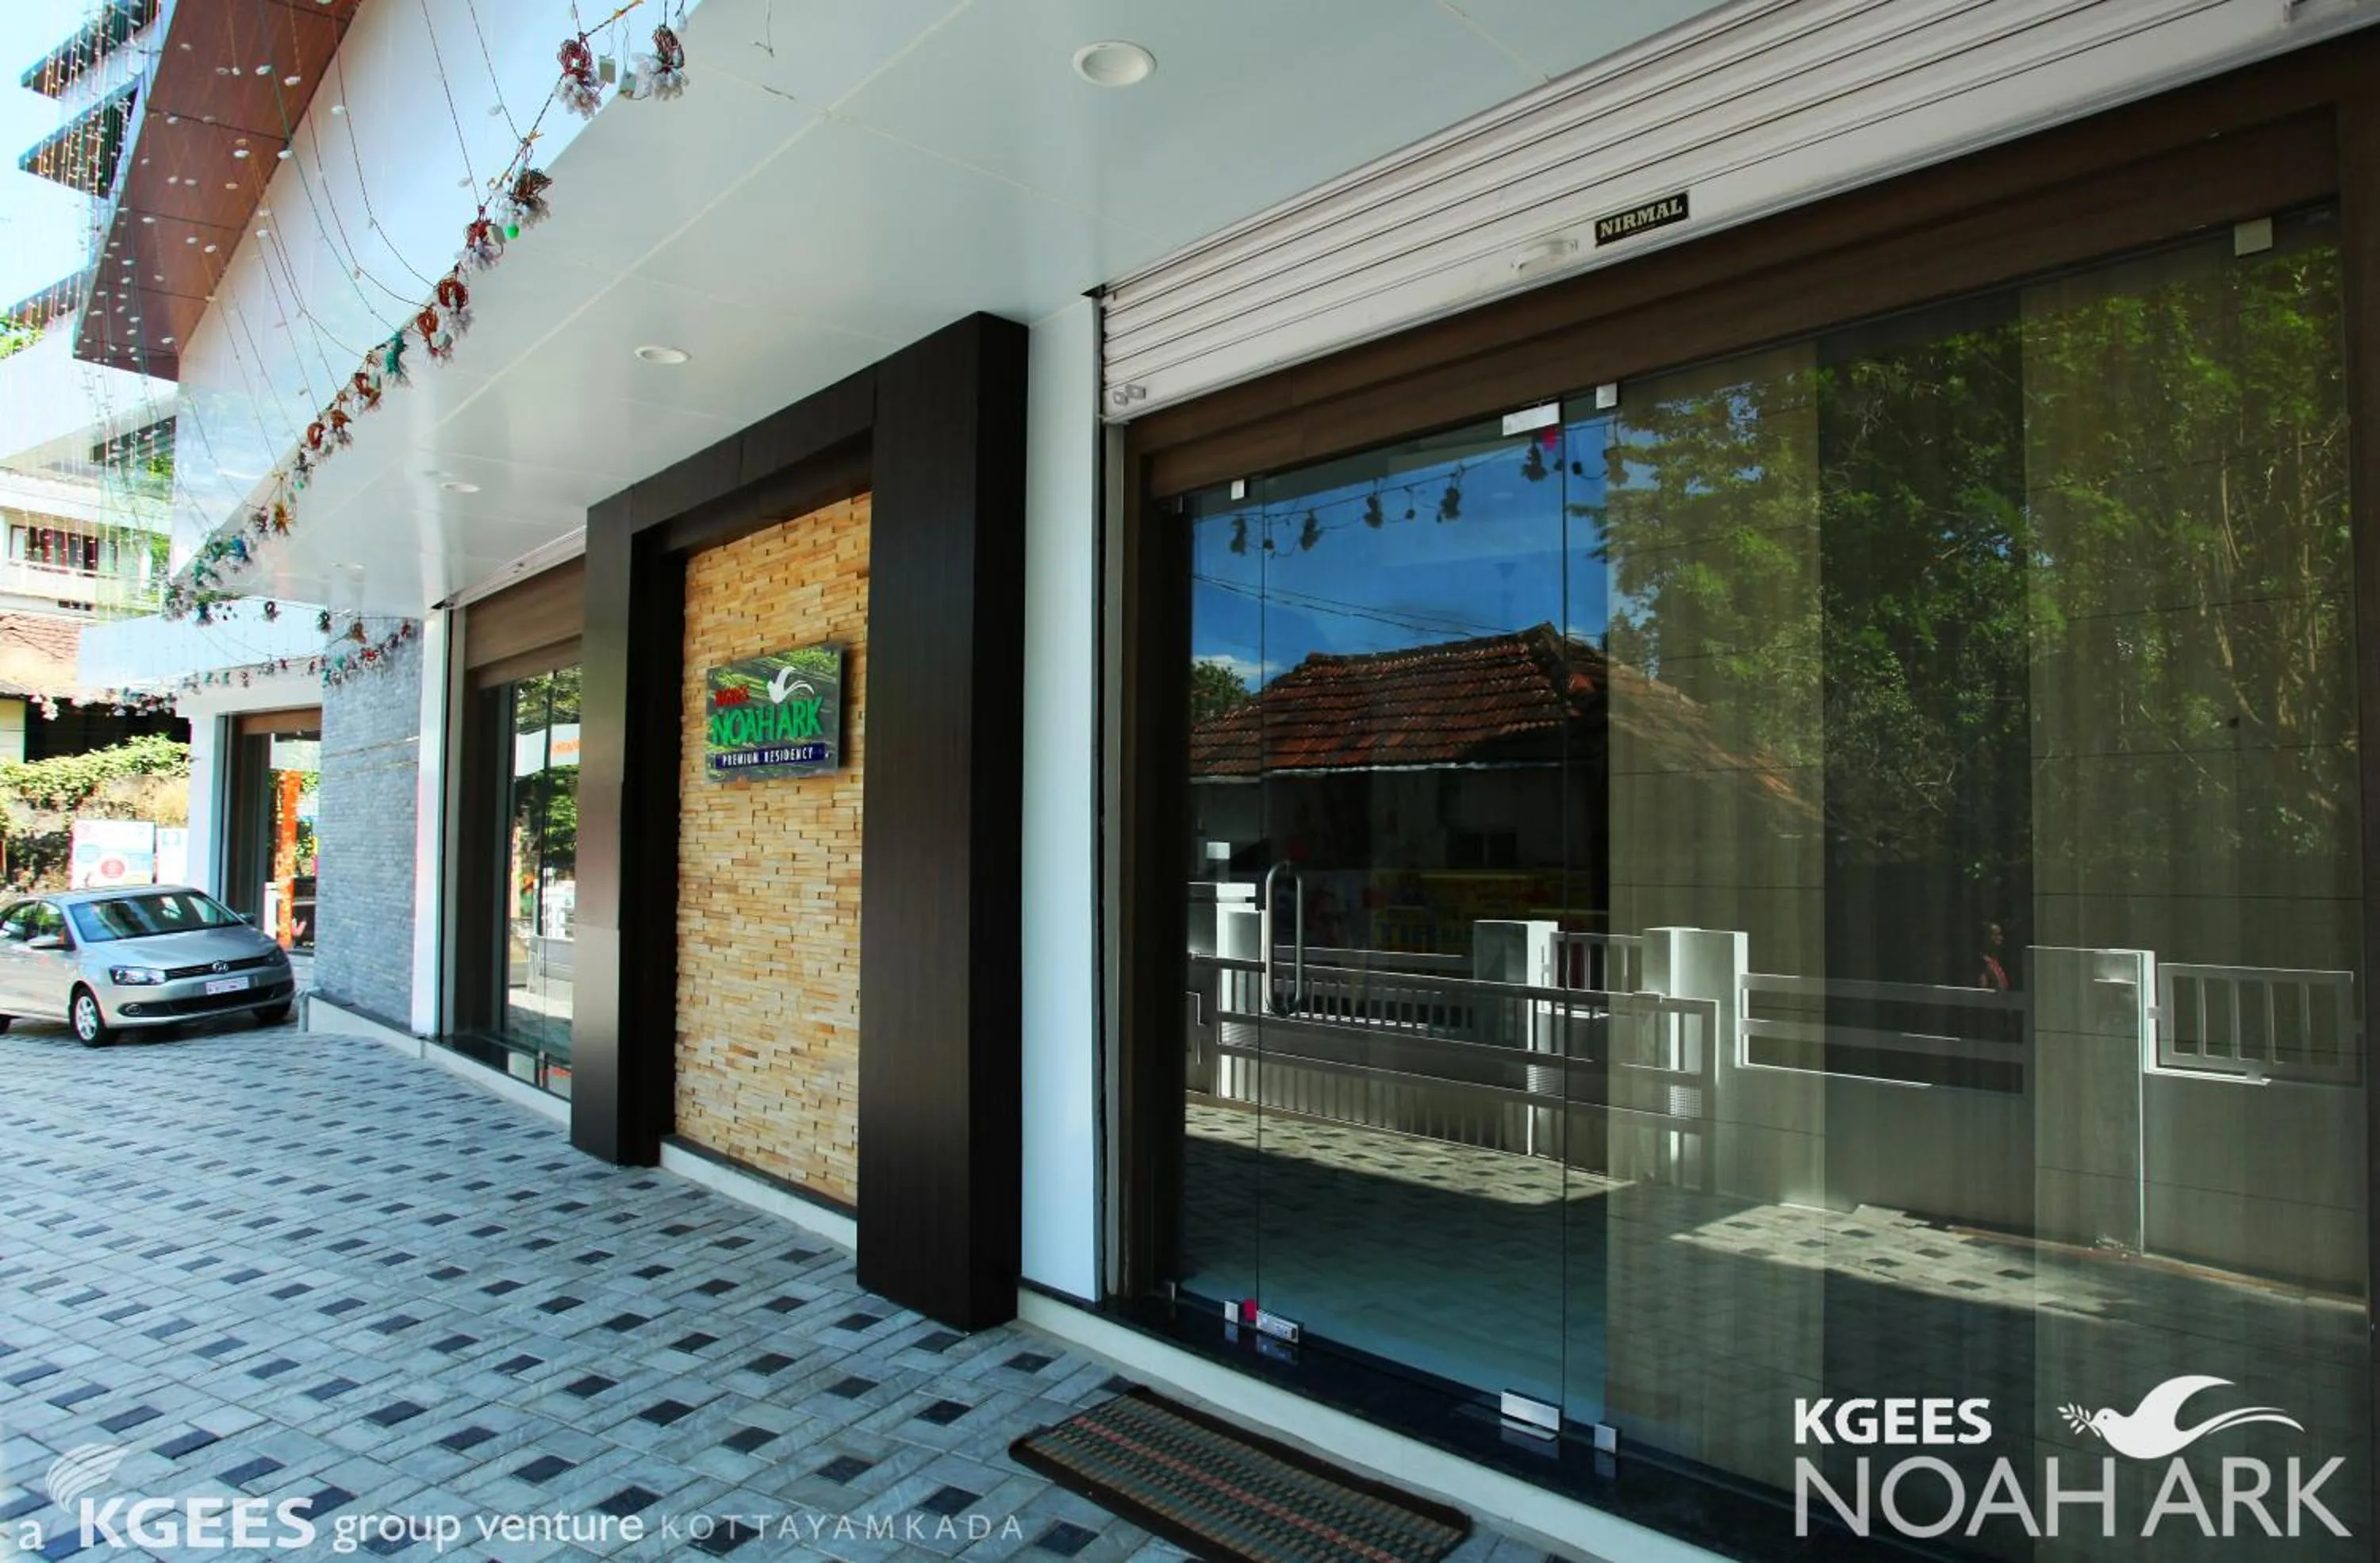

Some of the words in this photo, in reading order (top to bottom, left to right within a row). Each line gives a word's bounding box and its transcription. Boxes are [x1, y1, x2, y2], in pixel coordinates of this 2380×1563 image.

[1599, 198, 1683, 238] NIRMAL
[712, 704, 775, 747] NOAH
[776, 696, 823, 739] ARK
[723, 751, 759, 766] PREMIUM
[764, 747, 813, 763] RESIDENCY
